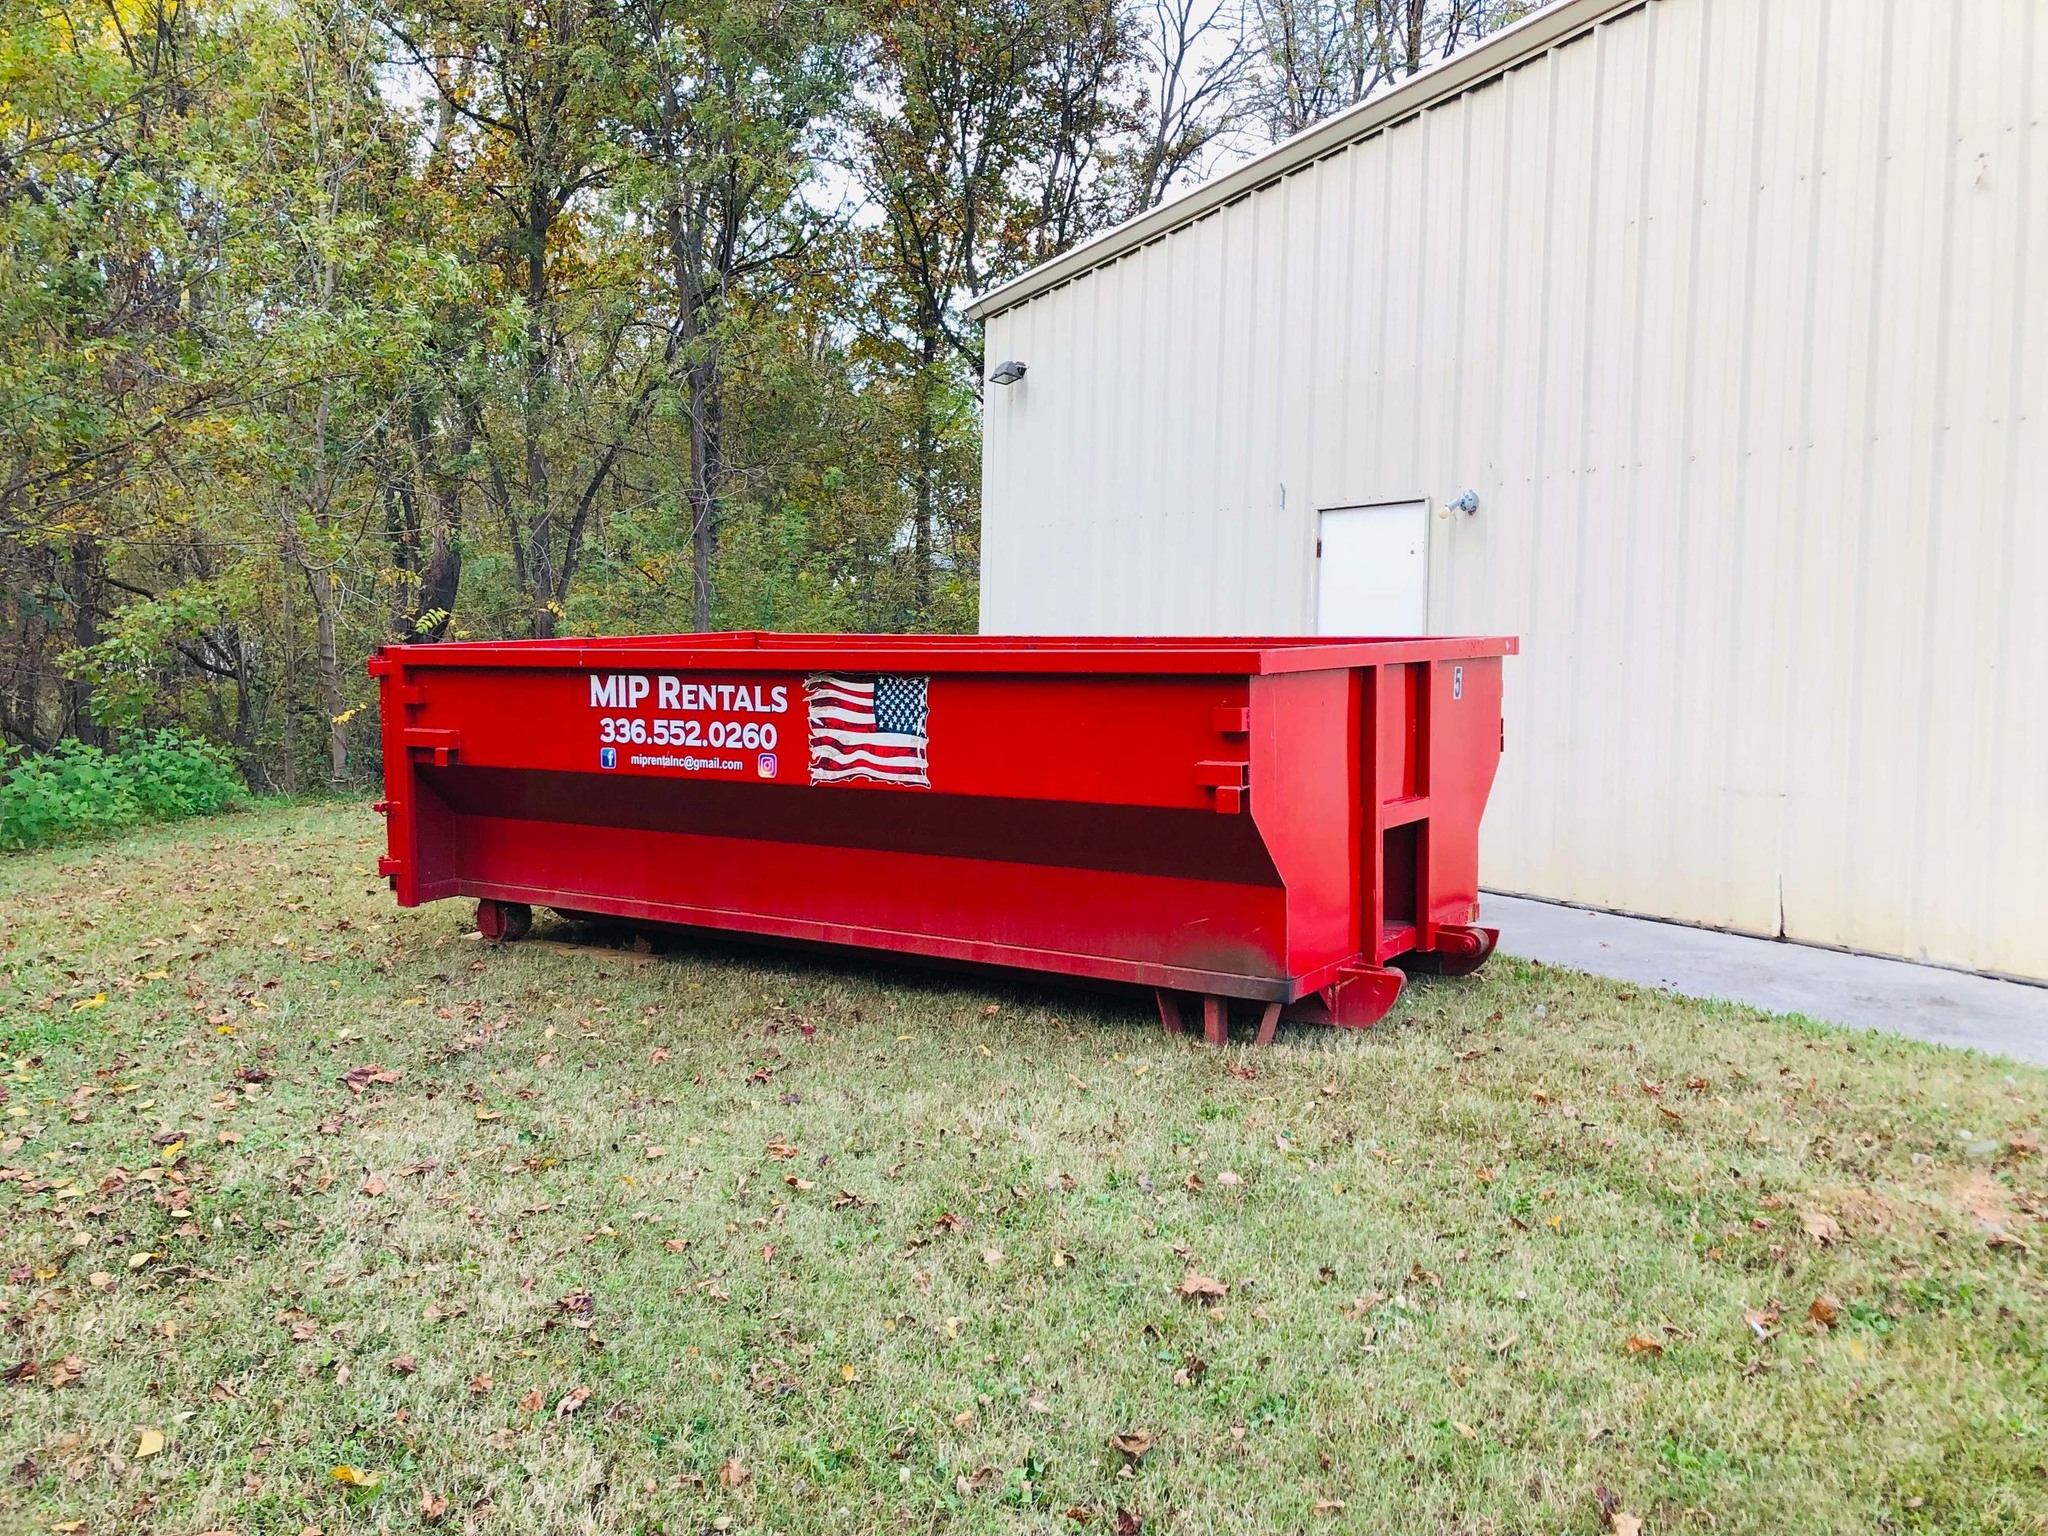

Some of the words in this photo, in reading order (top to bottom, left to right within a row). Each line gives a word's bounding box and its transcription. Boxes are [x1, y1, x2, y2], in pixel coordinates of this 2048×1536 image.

[589, 675, 649, 709] MIP
[1455, 668, 1461, 697] 5
[600, 718, 777, 750] 336.552.0260
